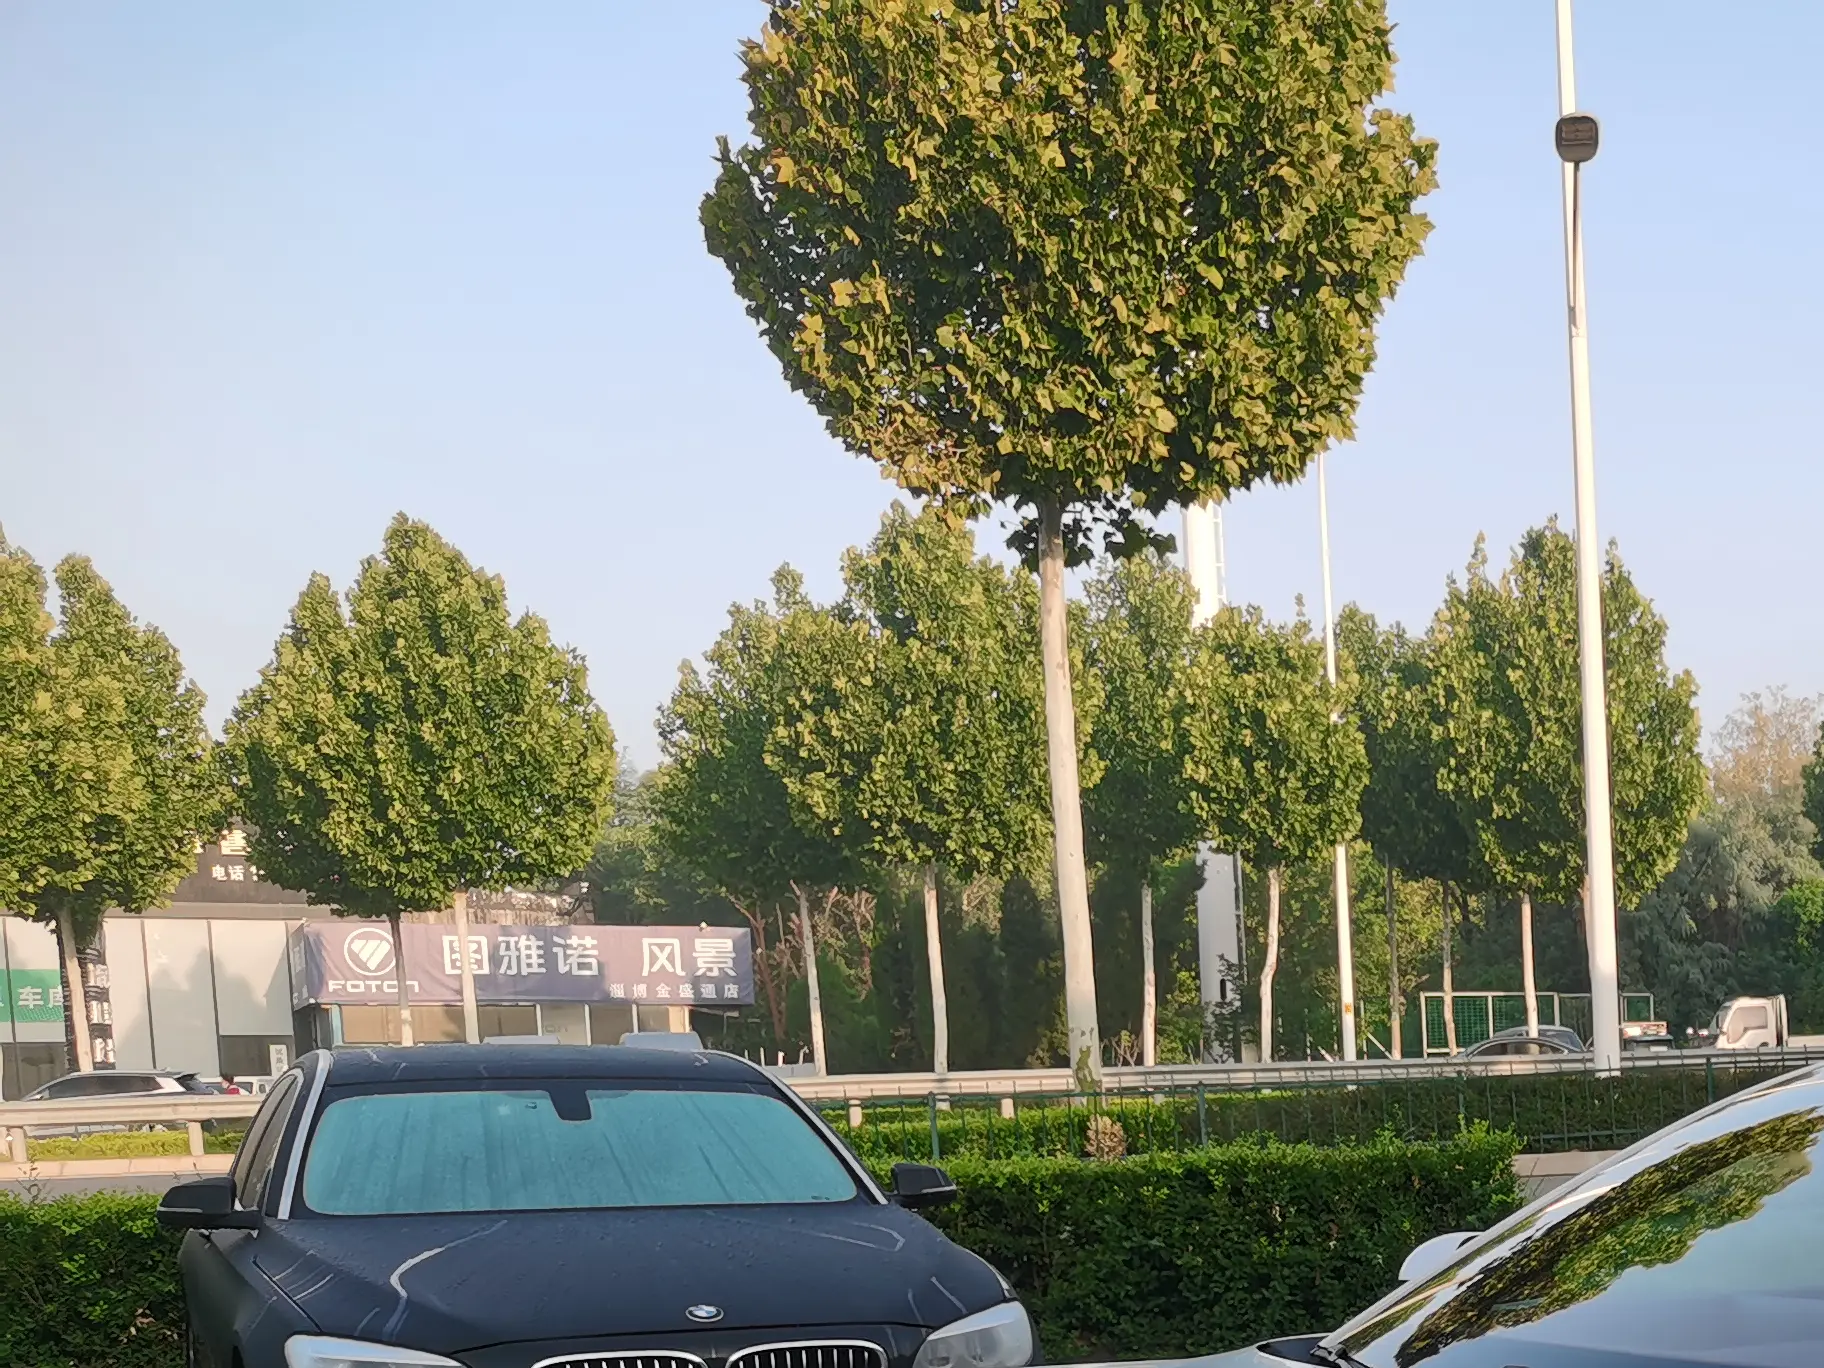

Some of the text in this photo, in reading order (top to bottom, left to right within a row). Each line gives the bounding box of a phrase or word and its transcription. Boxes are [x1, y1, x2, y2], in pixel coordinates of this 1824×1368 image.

[442, 934, 738, 976] 图雅诺 风景
